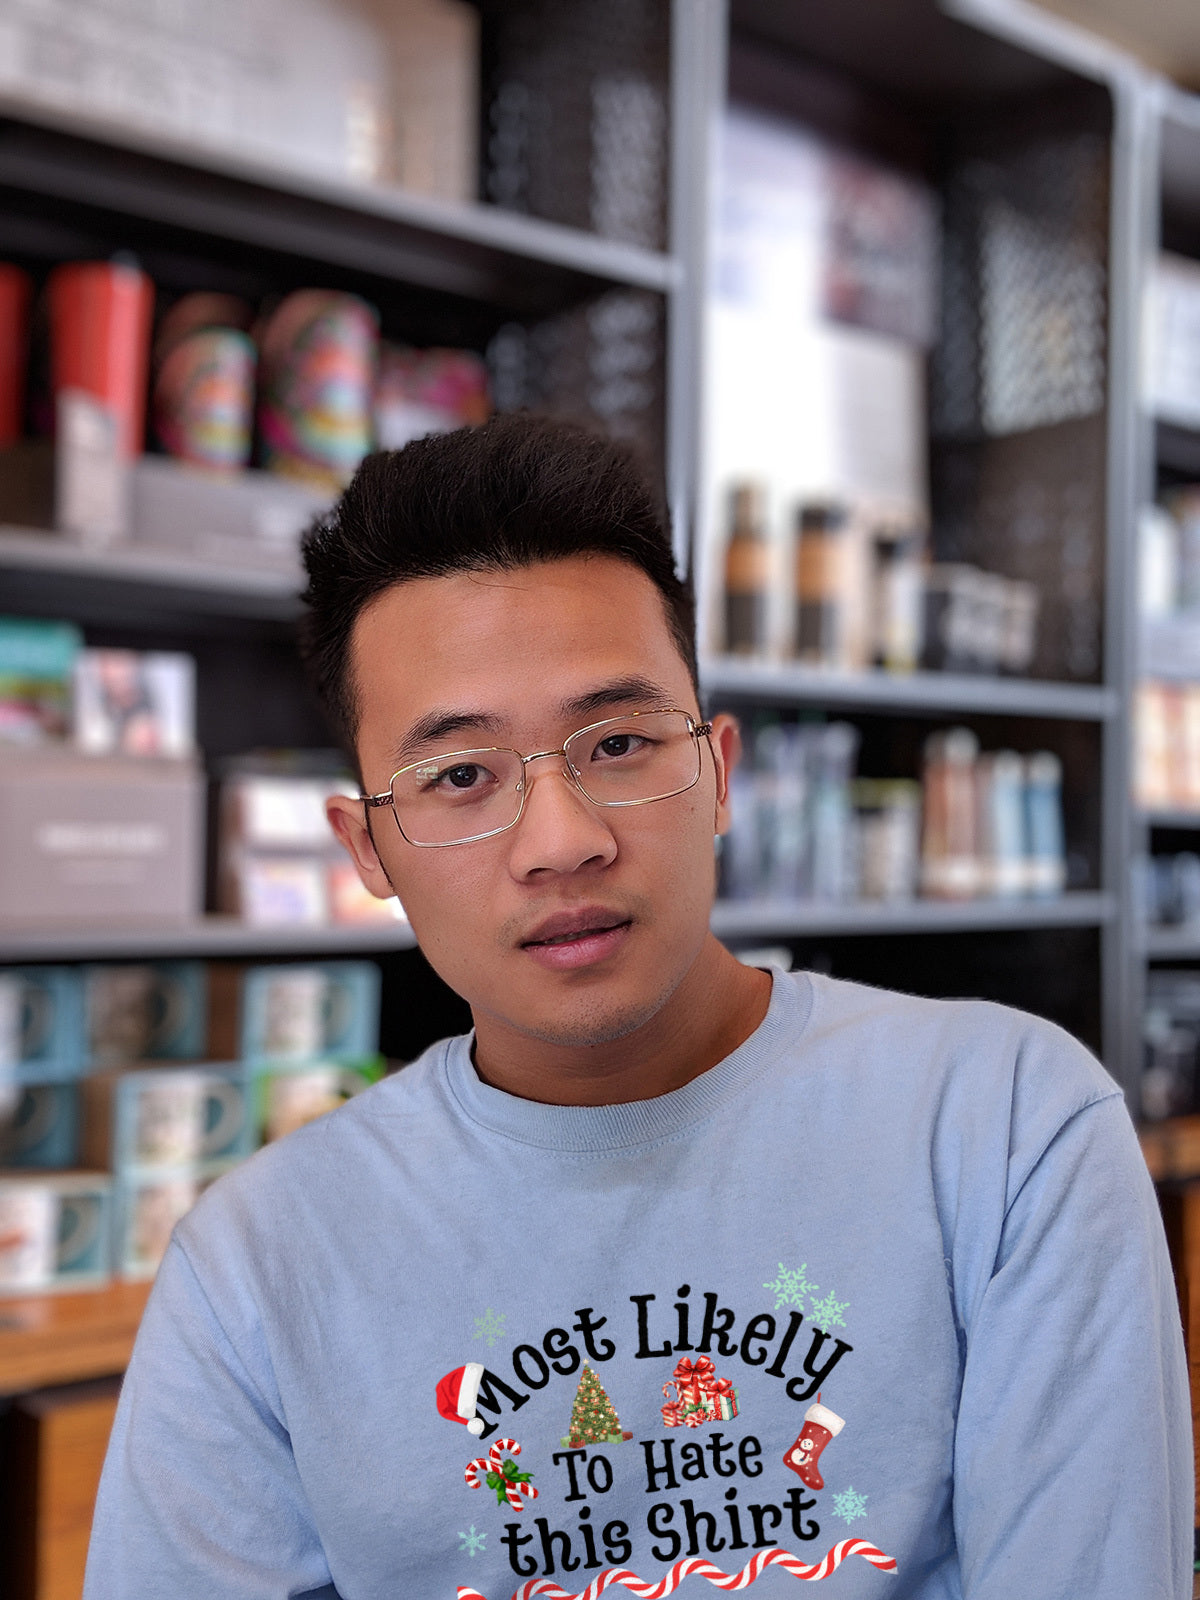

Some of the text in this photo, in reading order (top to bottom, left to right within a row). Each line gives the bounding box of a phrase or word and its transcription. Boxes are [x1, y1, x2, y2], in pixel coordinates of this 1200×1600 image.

[474, 1284, 854, 1440] Most Likely
[552, 1432, 763, 1503] To Hate
[500, 1487, 820, 1577] this Shirt
